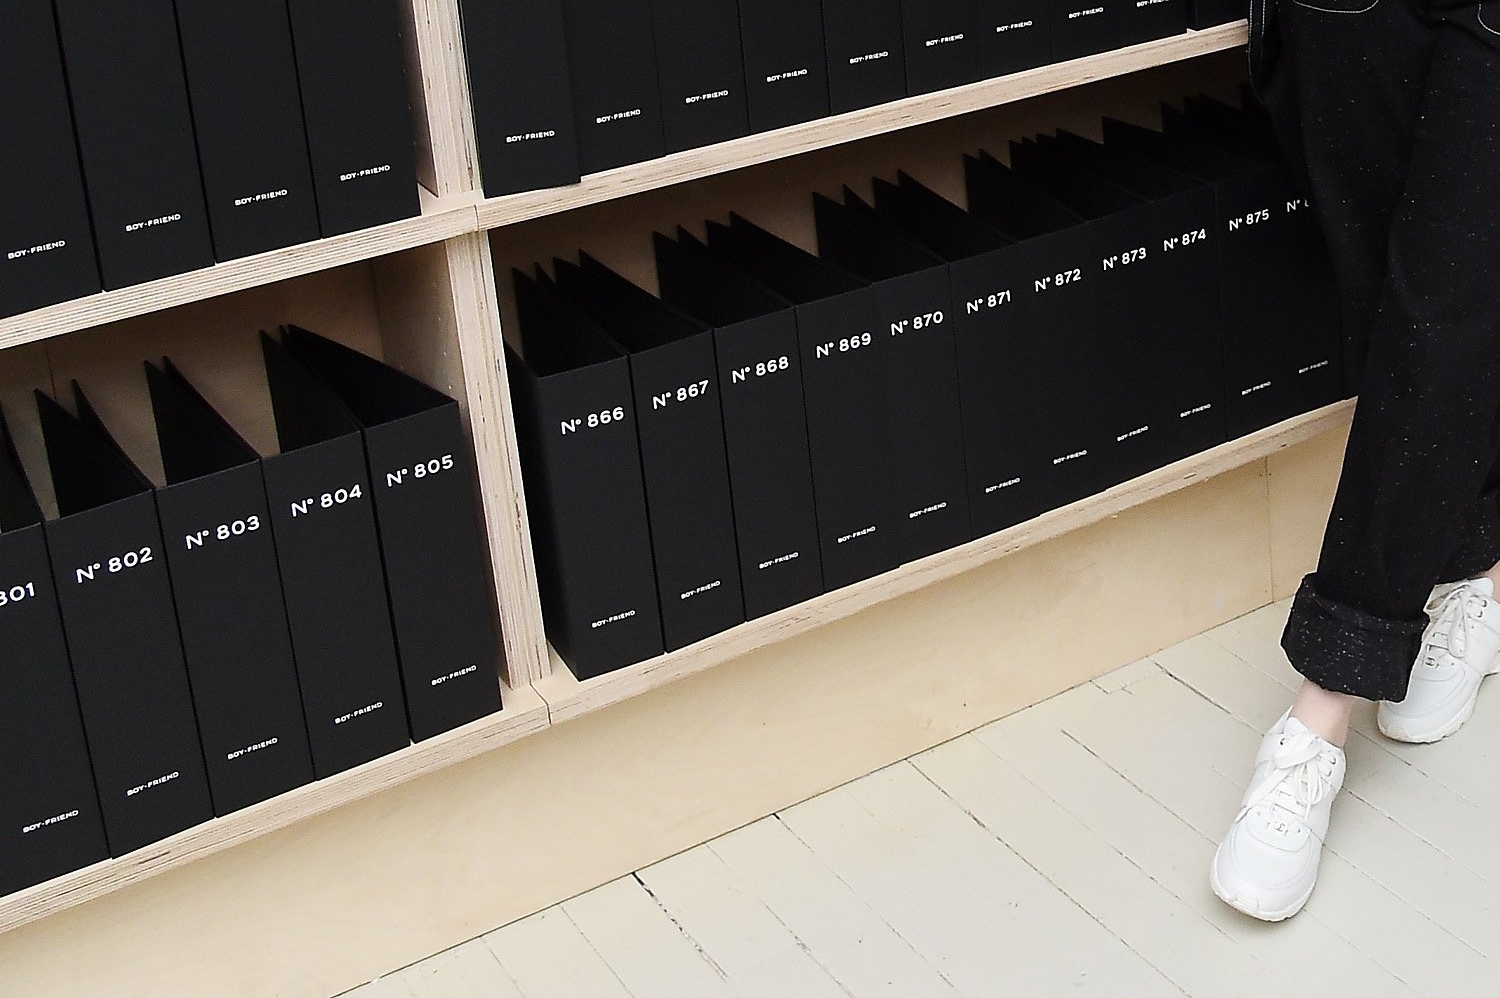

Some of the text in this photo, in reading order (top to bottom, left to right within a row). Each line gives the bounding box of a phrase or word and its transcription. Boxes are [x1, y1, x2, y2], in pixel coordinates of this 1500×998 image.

[1181, 228, 1207, 246] 874
[1055, 268, 1082, 286] 872
[913, 310, 944, 330] 870
[839, 332, 872, 352] 869
[755, 355, 789, 377] 868
[587, 406, 624, 428] 866
[414, 454, 454, 478] 805
[320, 484, 363, 508] 804
[216, 515, 260, 540] 803
[108, 546, 153, 573] 802
